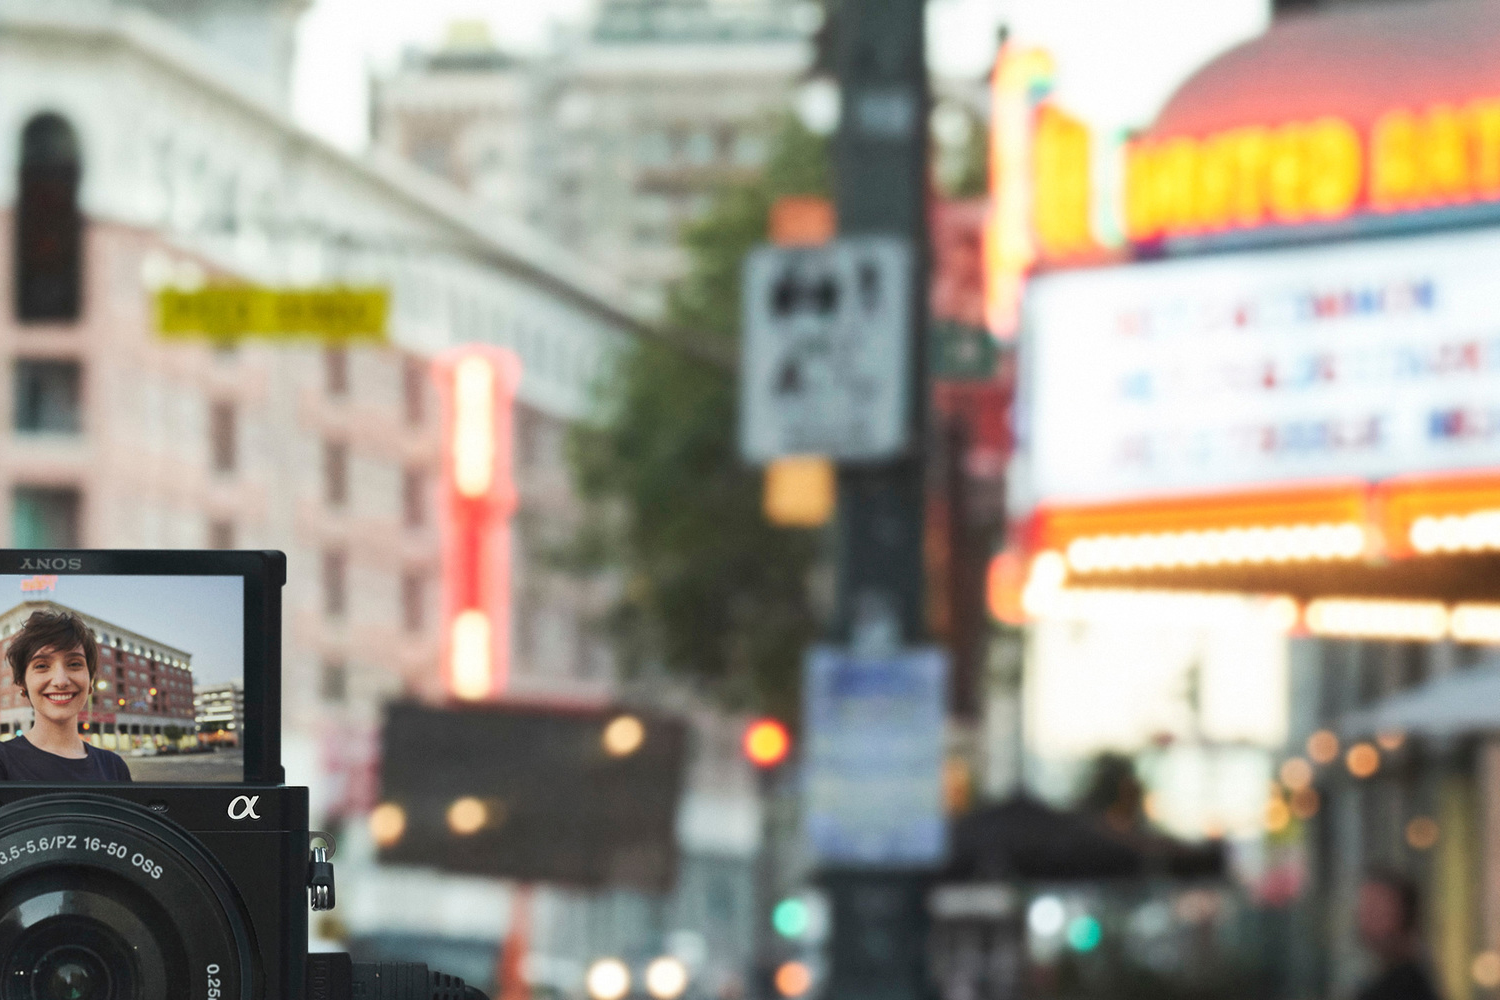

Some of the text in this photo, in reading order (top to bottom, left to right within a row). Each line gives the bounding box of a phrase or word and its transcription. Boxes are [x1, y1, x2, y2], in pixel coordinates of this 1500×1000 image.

[19, 557, 82, 571] SONY
[83, 836, 128, 859] 16-50
[131, 852, 164, 880] OSS
